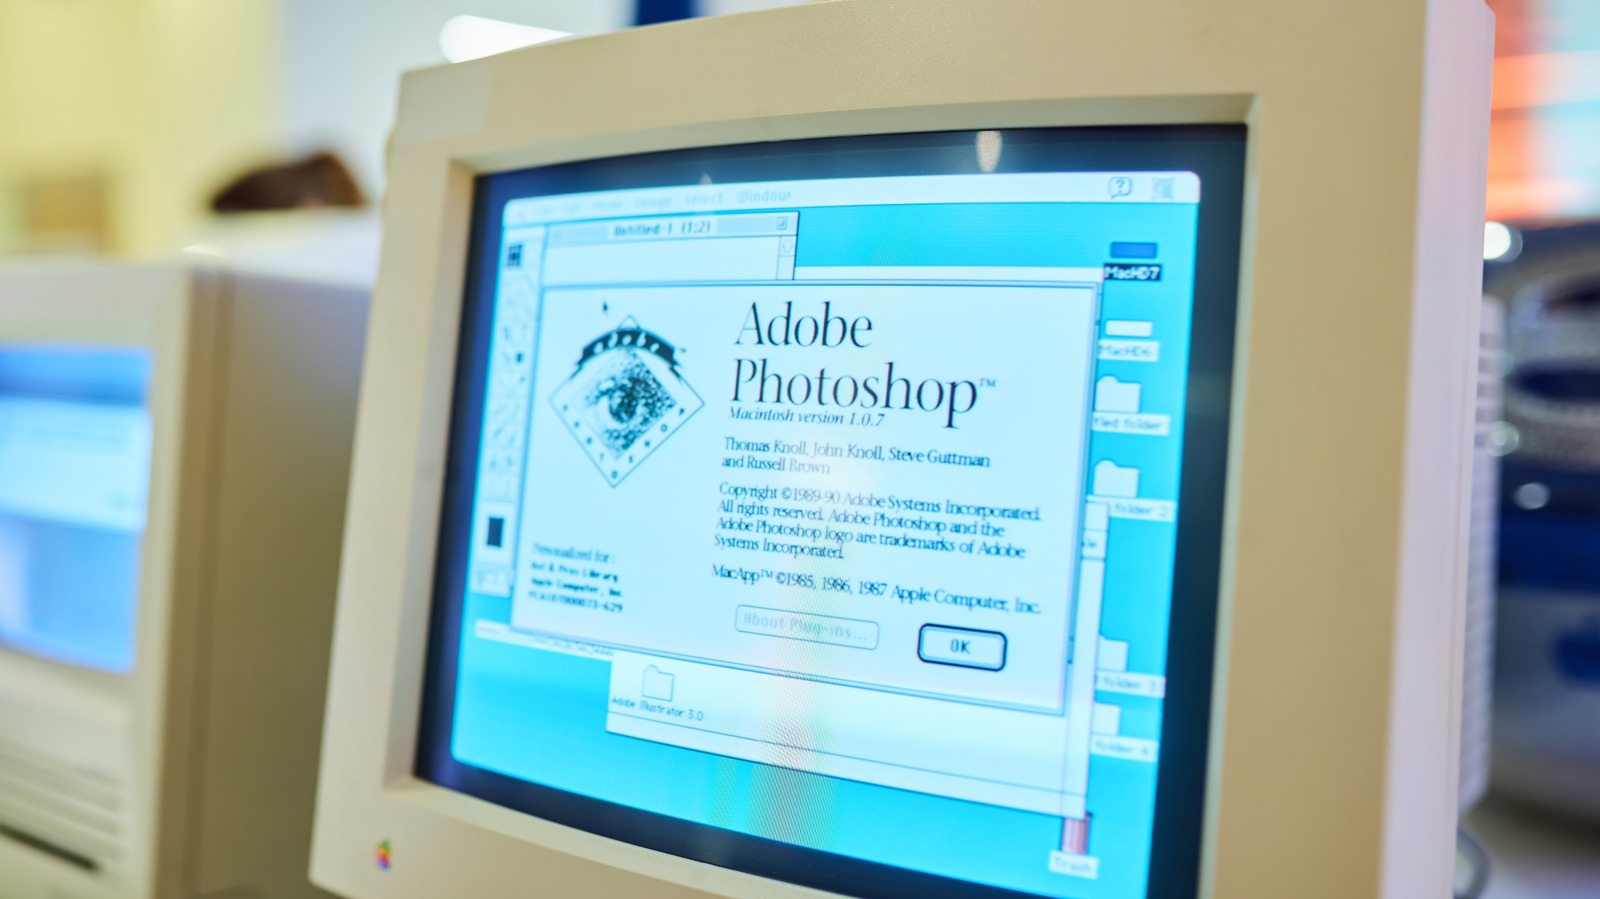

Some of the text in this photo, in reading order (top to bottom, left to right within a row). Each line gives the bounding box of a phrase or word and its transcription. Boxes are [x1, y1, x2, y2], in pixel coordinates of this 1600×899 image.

[685, 191, 724, 207] Select
[736, 188, 791, 204] Window
[681, 220, 712, 235] (1:2)
[1104, 264, 1161, 280] MacHD7
[734, 301, 872, 348] Adobe
[729, 406, 885, 427] Macintosh version 1.0.7
[724, 436, 991, 468] Thomas Knoll, John Knoll, Steve Guttman
[722, 455, 831, 475] and Russell Brown
[719, 481, 778, 502] Copyright
[844, 491, 886, 509] Adobe
[888, 494, 941, 514] Systems
[945, 499, 1042, 522] Incorporated.
[717, 500, 1005, 537] All rights reserved. Adobe Photoshop and the
[714, 534, 844, 560] Systems Incorporated.
[715, 517, 1026, 559] Adobe Photoshop logo are trademarks of Adobe
[583, 568, 618, 583] Library
[821, 576, 853, 595] 1986,
[858, 581, 887, 597] 1987
[890, 584, 931, 605] Apple
[934, 589, 1010, 614] Computer,
[1013, 597, 1042, 615] Inc.
[743, 612, 784, 631] About
[950, 639, 971, 655] OK
[611, 696, 704, 722] Adobe Illustrator 3.0
